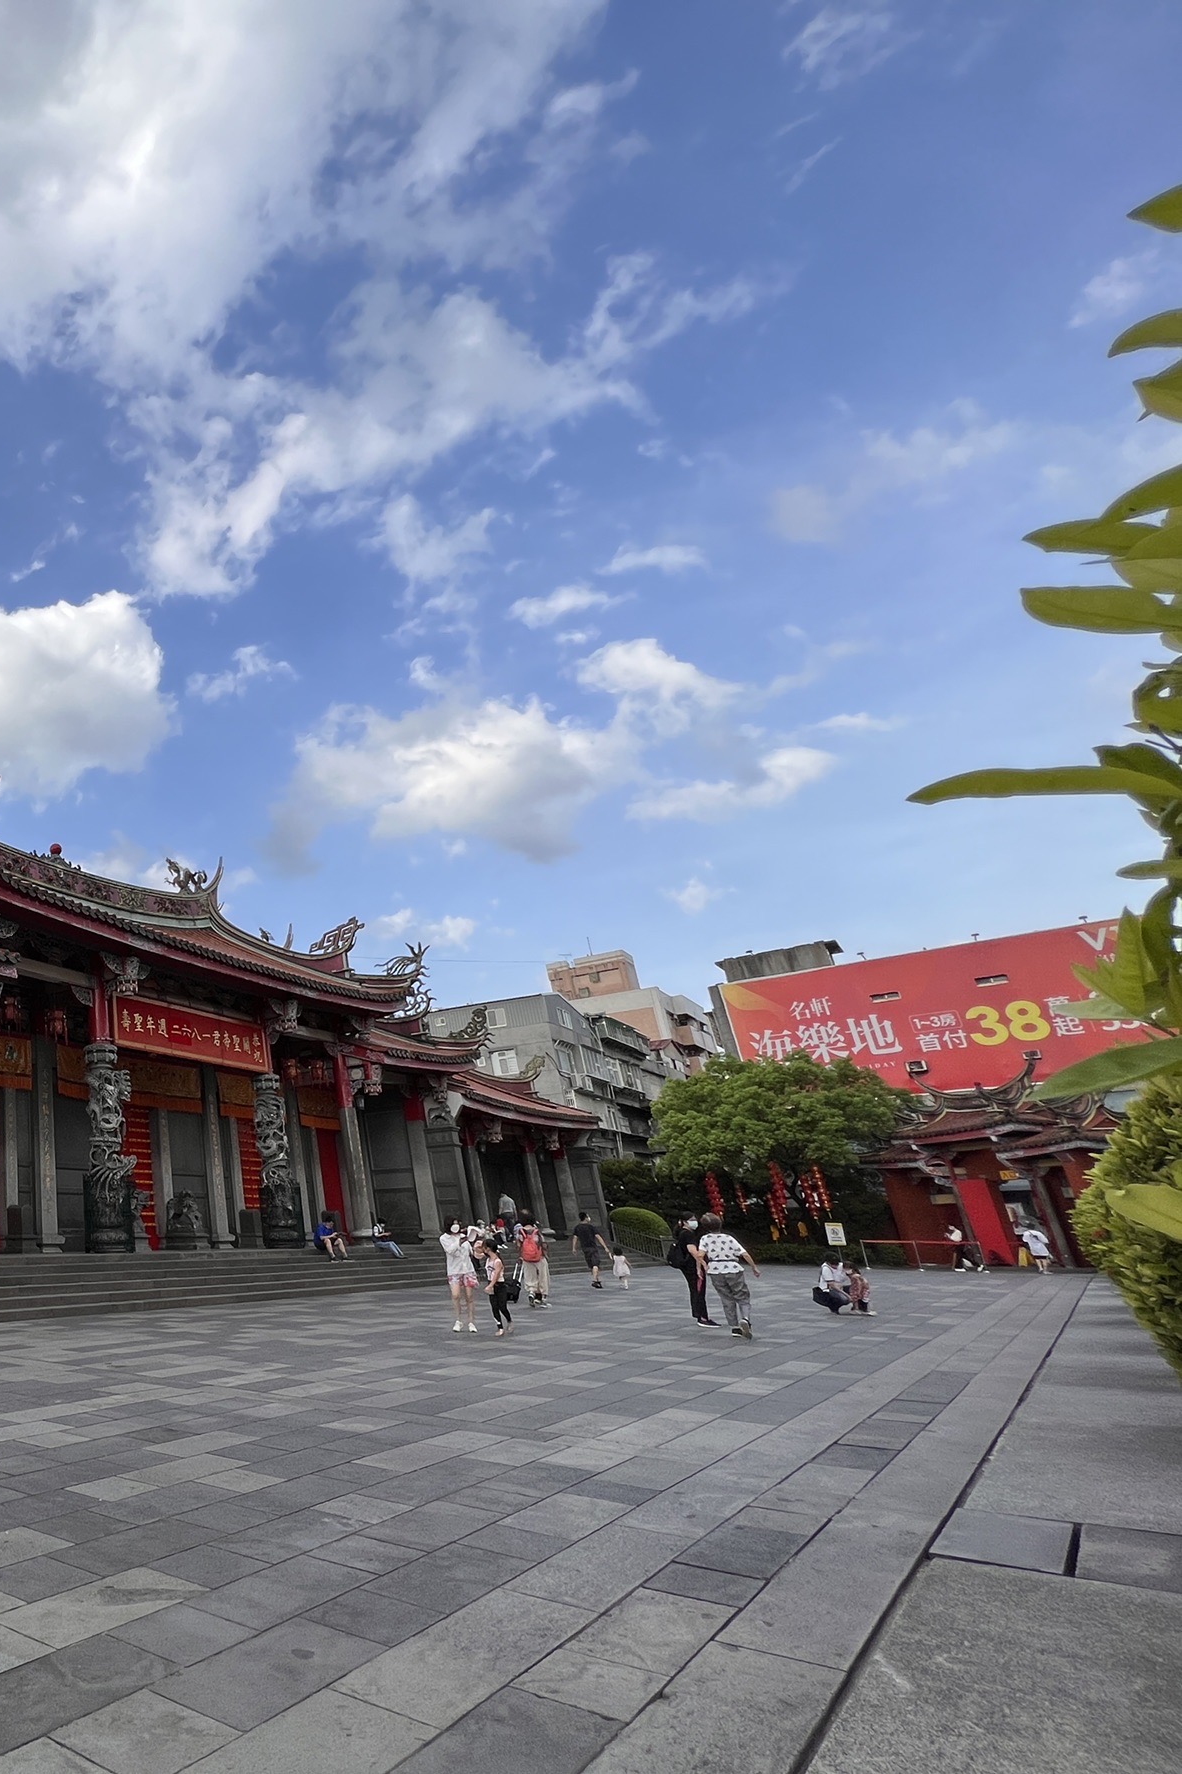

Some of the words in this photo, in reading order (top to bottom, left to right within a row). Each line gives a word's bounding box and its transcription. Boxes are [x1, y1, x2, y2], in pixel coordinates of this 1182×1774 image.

[789, 996, 832, 1020] 名軒
[916, 1029, 967, 1053] 首付
[965, 1000, 1051, 1046] 38
[749, 1014, 903, 1066] 海樂地
